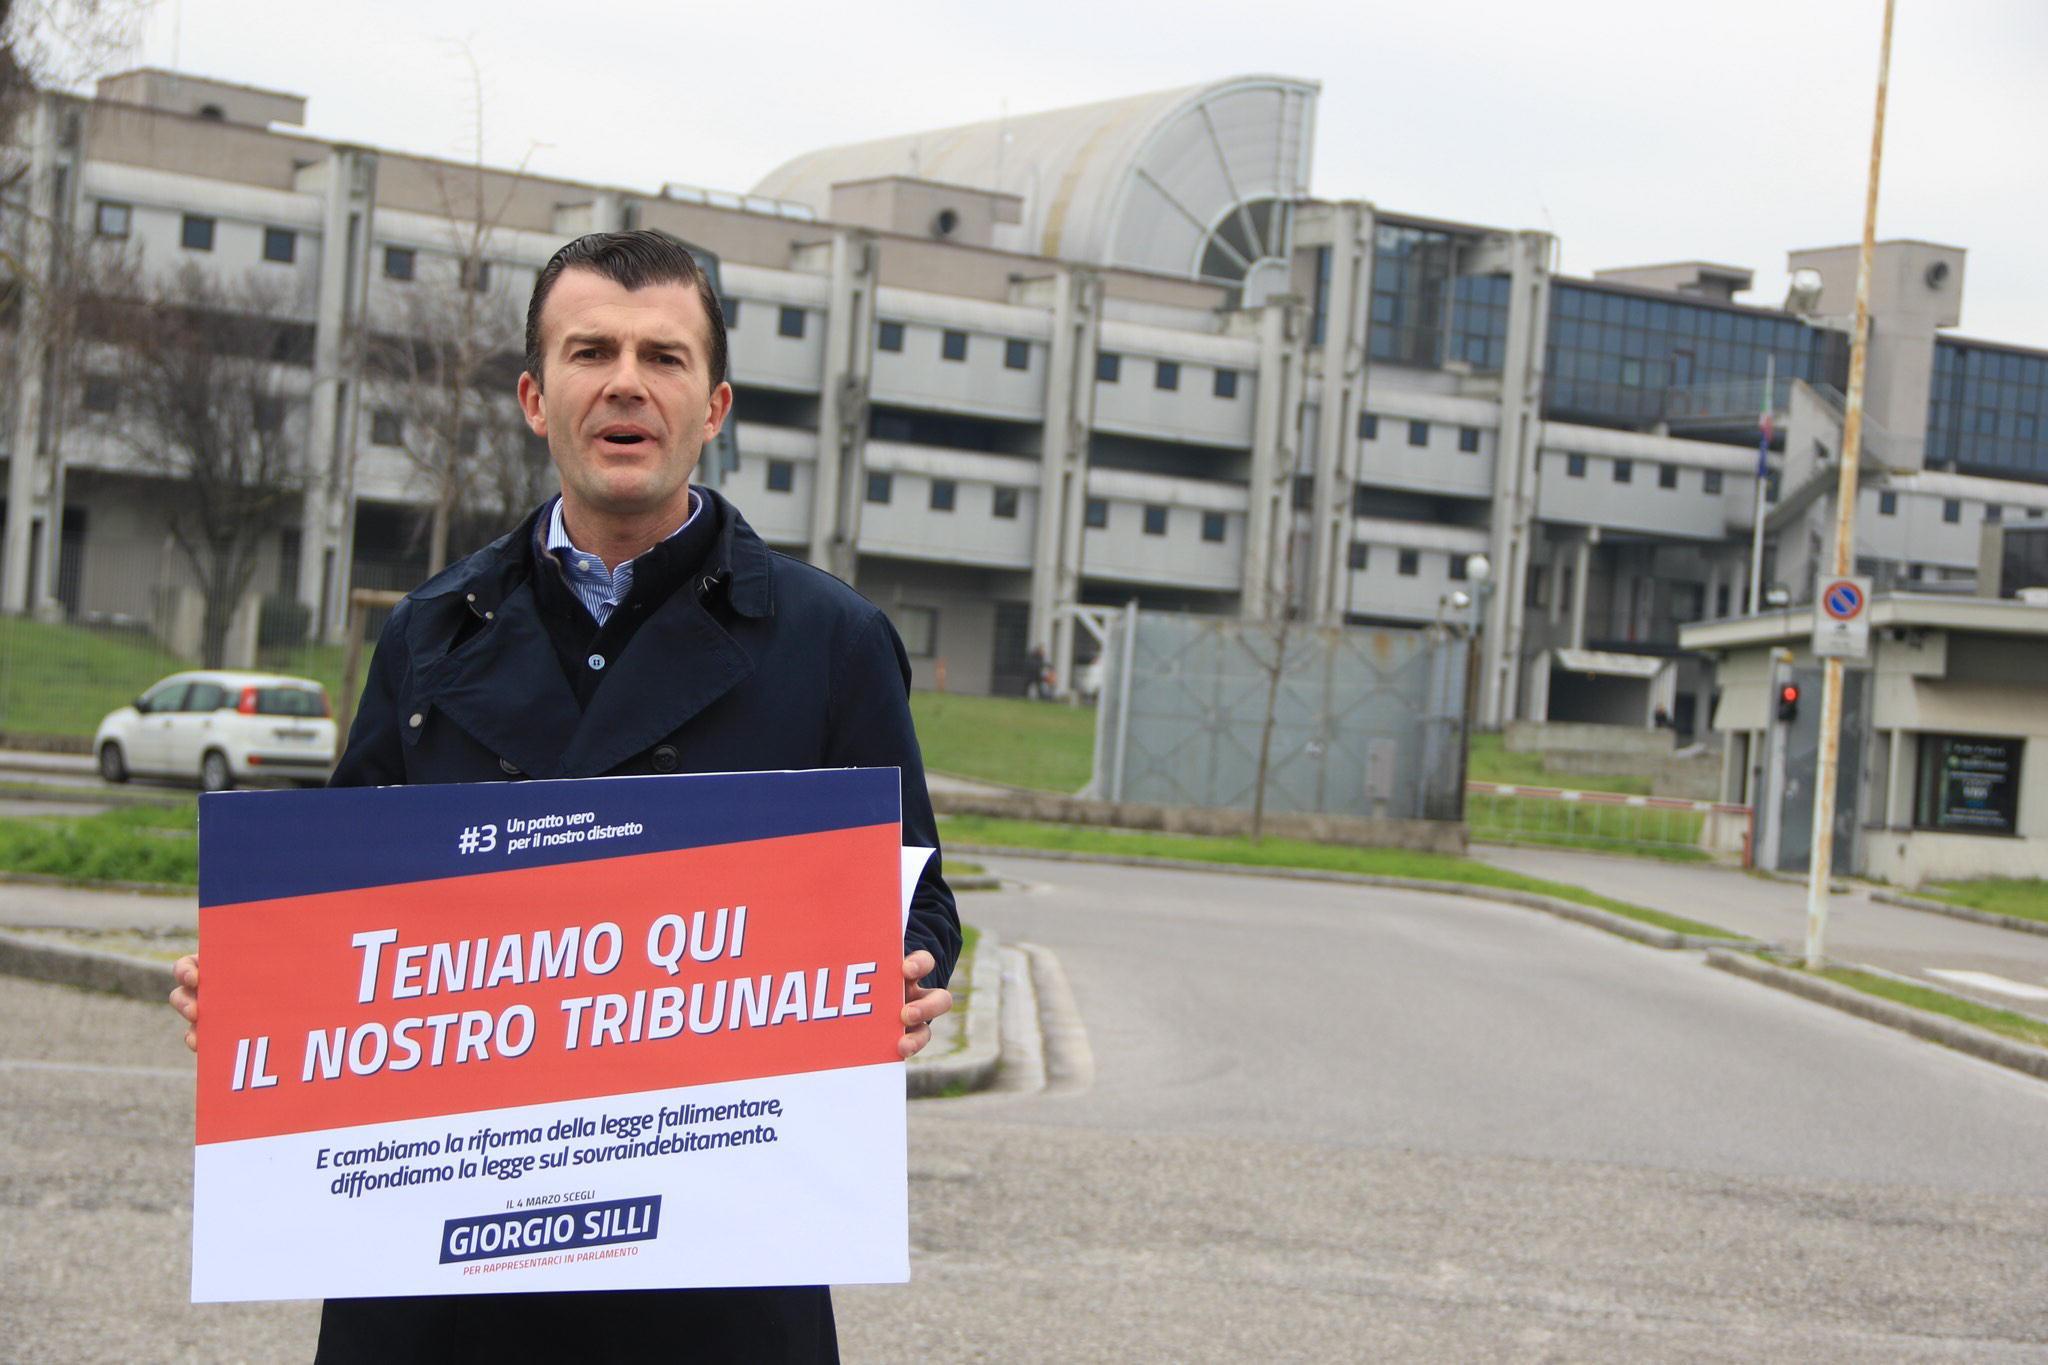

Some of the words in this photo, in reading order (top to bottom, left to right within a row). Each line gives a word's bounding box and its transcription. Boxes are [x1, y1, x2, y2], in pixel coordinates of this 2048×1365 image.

[458, 824, 497, 854] #3
[507, 818, 525, 833] Un
[527, 815, 563, 834] patto
[566, 811, 595, 825] vero
[507, 836, 531, 854] per
[533, 834, 541, 847] il
[543, 830, 585, 846] nostro
[587, 822, 643, 840] distretto
[646, 906, 747, 975] QUI
[231, 1036, 278, 1091] IL
[302, 1004, 536, 1082] NOSTRO
[560, 962, 877, 1050] TRIBUNALE
[316, 1148, 330, 1170] E
[333, 1140, 440, 1167] cambiamo
[445, 1133, 463, 1153] la
[468, 1127, 542, 1155] riforma
[547, 1117, 595, 1141] della
[601, 1114, 653, 1139] legge
[657, 1099, 783, 1133] fallimentare,
[331, 1166, 454, 1198] diffondiamo
[459, 1158, 477, 1179] la
[481, 1155, 535, 1180] legge
[539, 1146, 568, 1169] sul
[572, 1126, 778, 1165] sovraindebitamento.
[506, 1200, 514, 1209] IL
[517, 1200, 523, 1208] 4
[525, 1194, 561, 1207] MARZO
[563, 1190, 595, 1202] SCEGLI
[449, 1214, 575, 1256] GIORGIO
[582, 1204, 652, 1240] SILLI
[463, 1266, 481, 1276] PER
[483, 1254, 562, 1274] RAPPRESENTARCI
[564, 1253, 574, 1264] IN
[577, 1246, 638, 1262] PARLAMENTO
